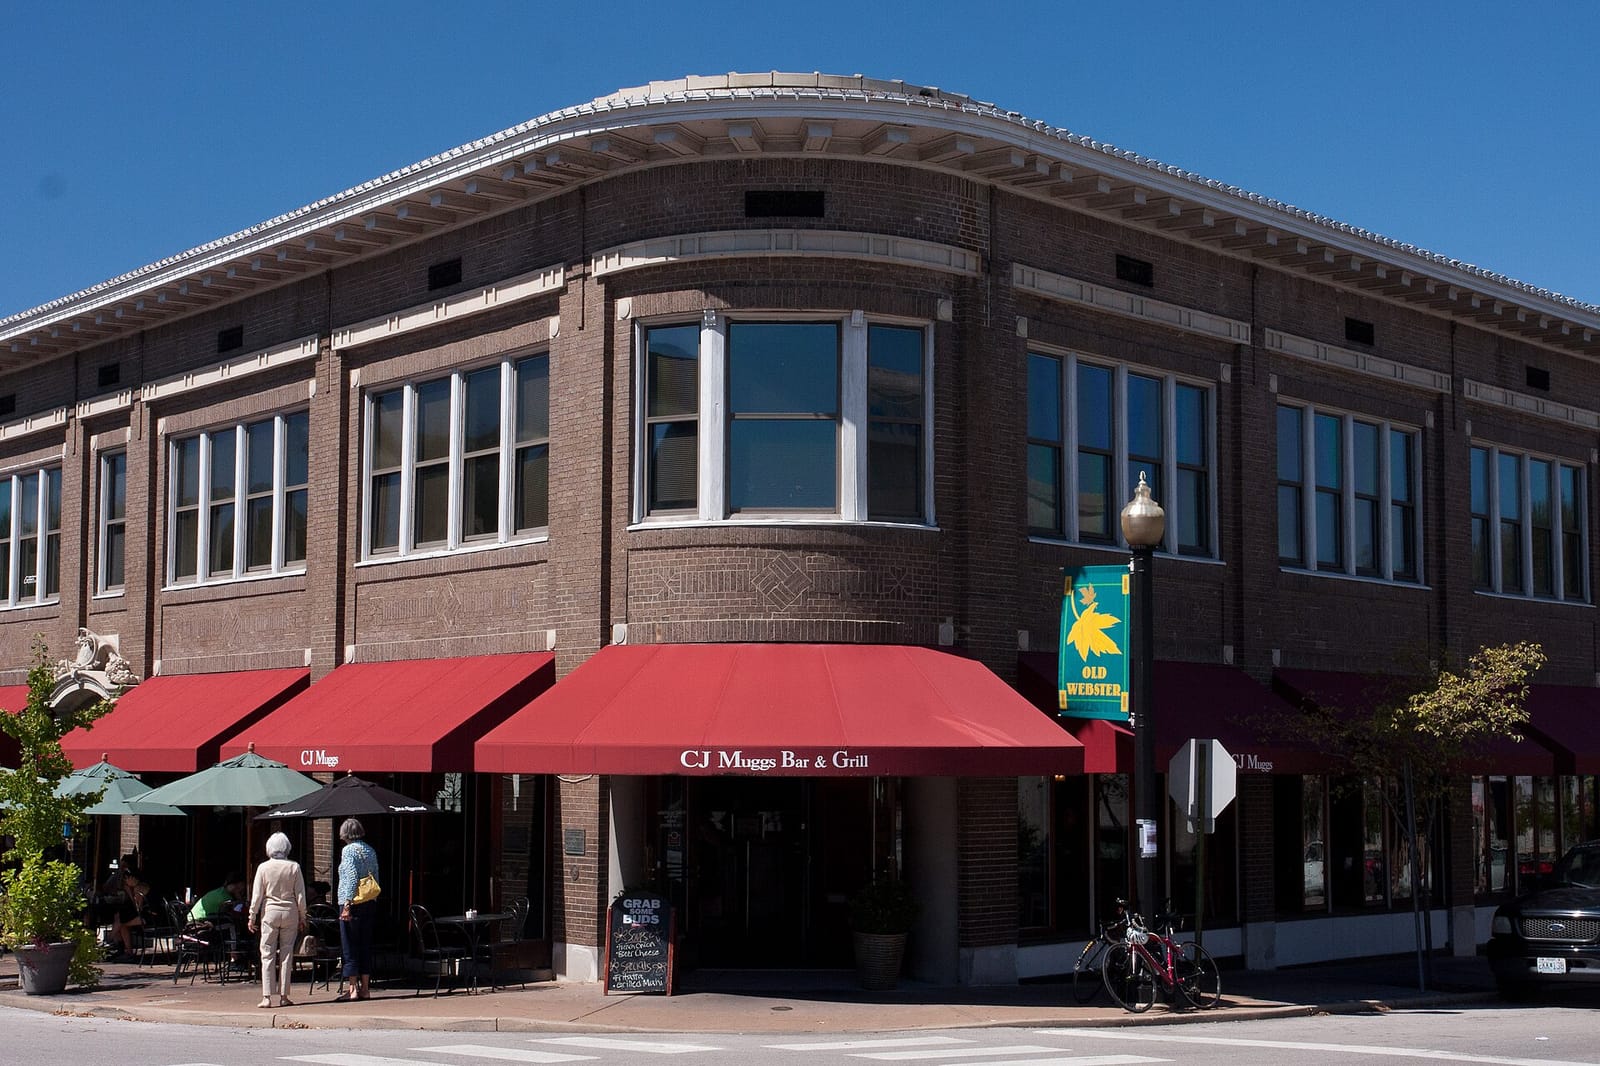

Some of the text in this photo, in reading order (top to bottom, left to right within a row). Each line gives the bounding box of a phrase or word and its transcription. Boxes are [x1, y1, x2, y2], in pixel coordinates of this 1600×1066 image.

[1082, 666, 1107, 679] OLD
[1066, 682, 1121, 697] WEBSTER
[301, 750, 339, 768] CJ Muggs
[680, 750, 869, 771] CJ Muggs Bar & Grill
[1247, 753, 1273, 772] Muggs
[623, 899, 661, 909] GRAB
[622, 914, 660, 924] BUDS
